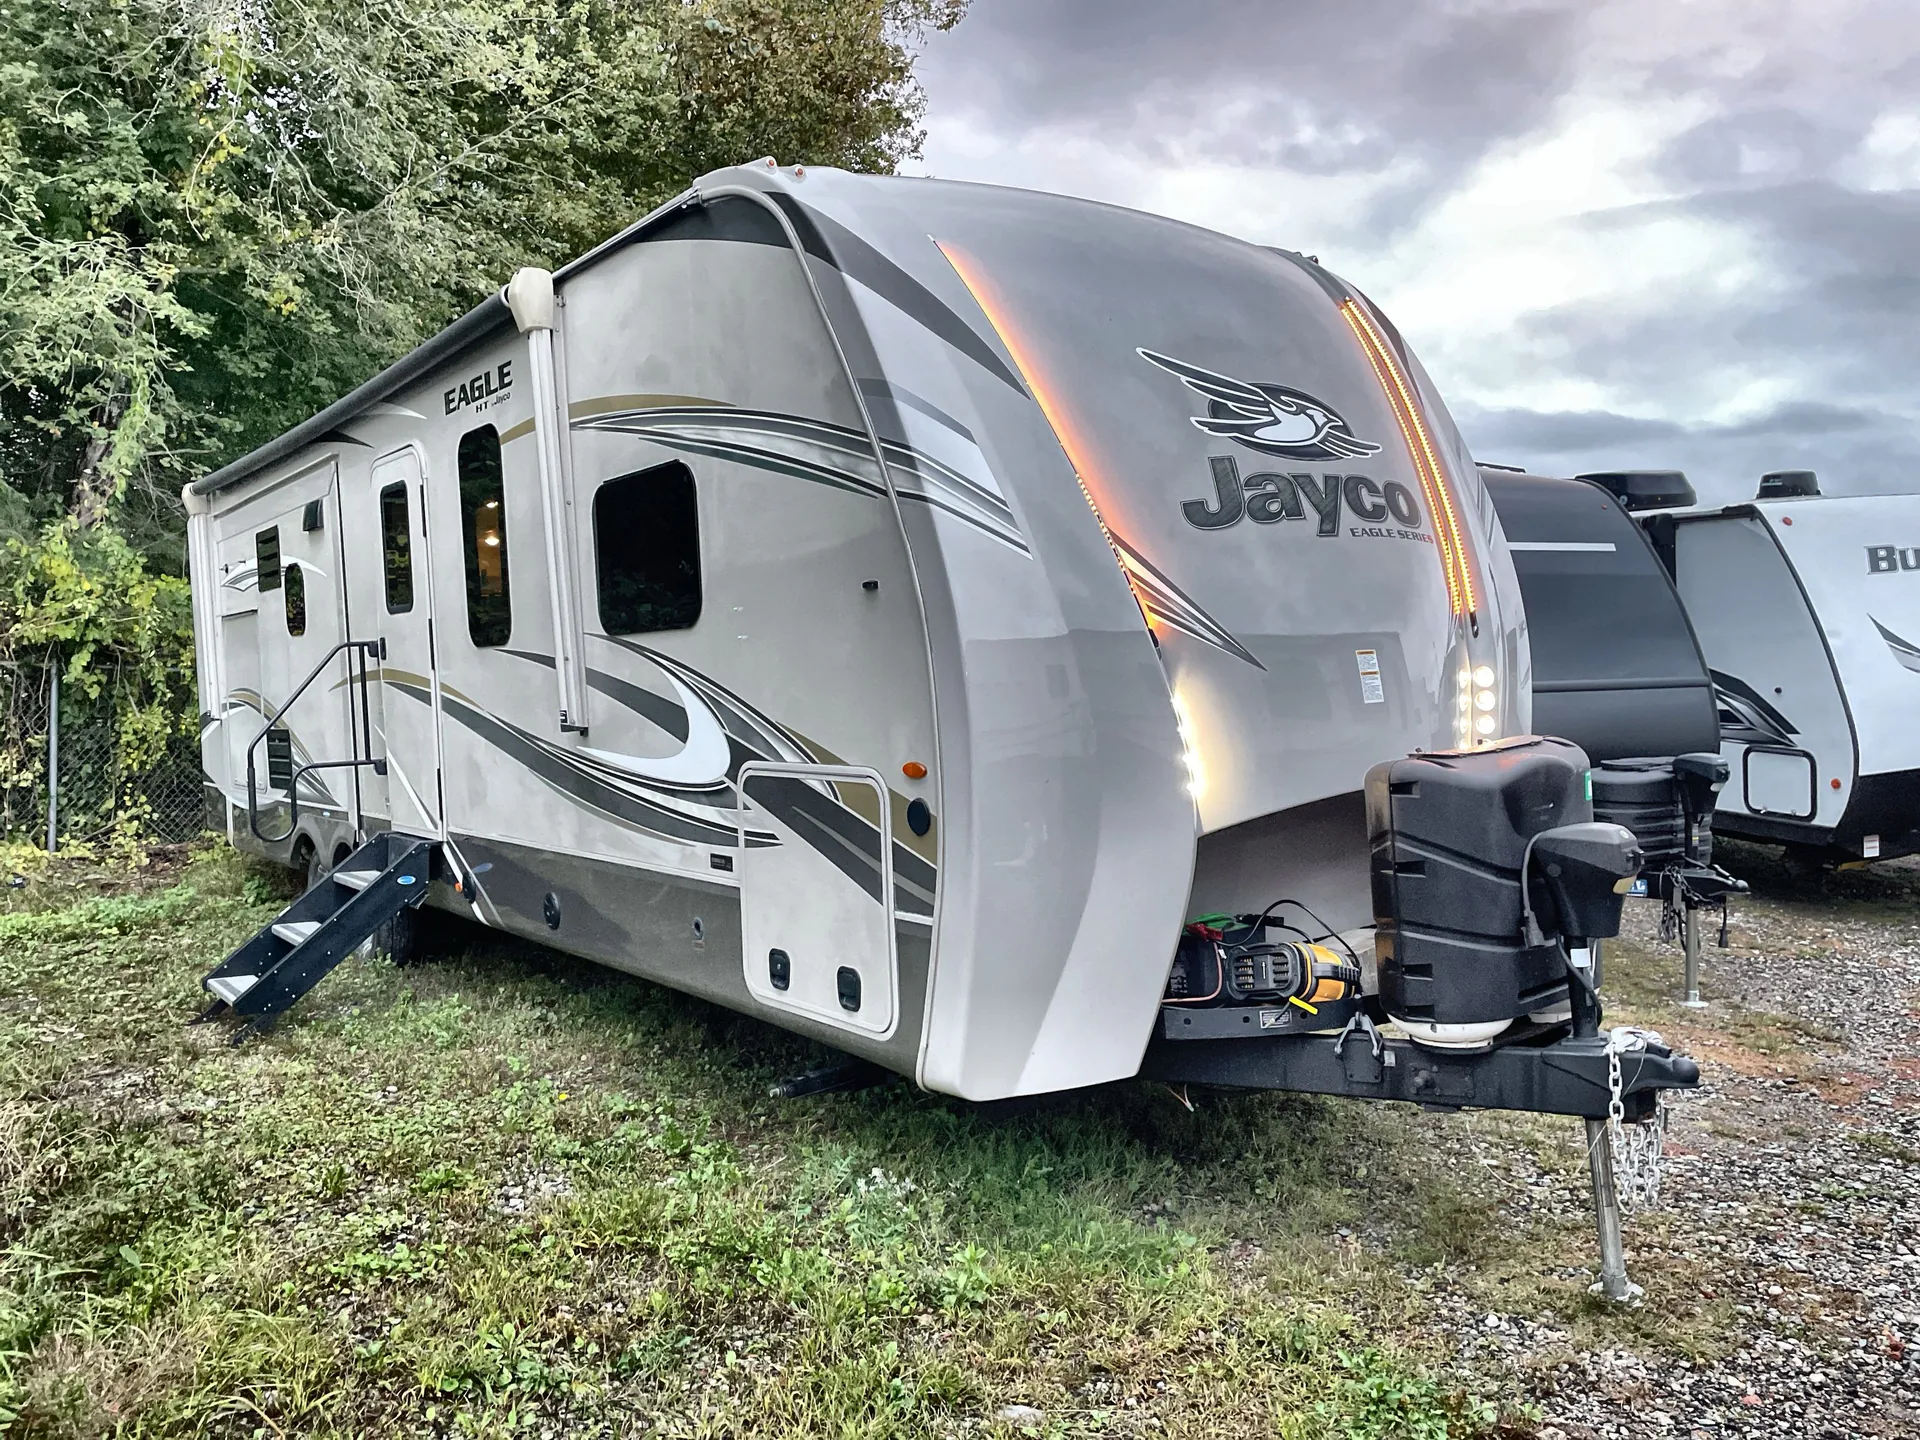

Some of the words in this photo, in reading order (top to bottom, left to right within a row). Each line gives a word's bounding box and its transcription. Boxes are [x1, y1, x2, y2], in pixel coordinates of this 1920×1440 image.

[444, 360, 513, 416] EAGLE
[476, 401, 489, 413] HT
[493, 392, 511, 405] Jayco
[1181, 456, 1421, 537] Jayco
[1350, 527, 1396, 538] EAGLE
[1397, 529, 1434, 545] SERIES
